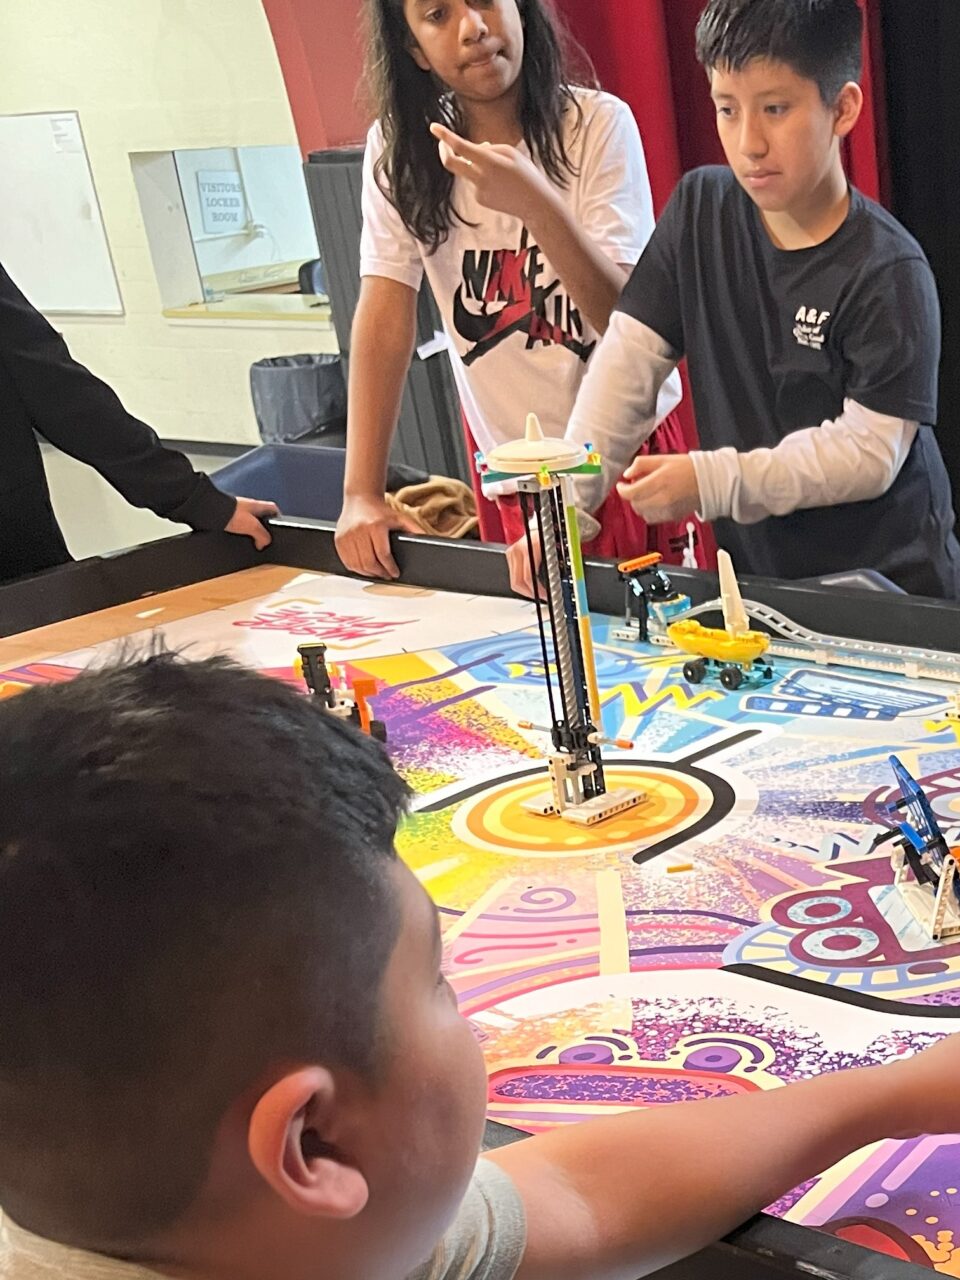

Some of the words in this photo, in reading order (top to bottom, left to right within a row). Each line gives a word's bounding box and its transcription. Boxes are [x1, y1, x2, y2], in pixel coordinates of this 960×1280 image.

[200, 182, 242, 193] VISITORS
[205, 197, 240, 207] LOCKER
[211, 212, 238, 222] ROOM
[462, 246, 543, 302] NIKE
[795, 305, 831, 325] A&F
